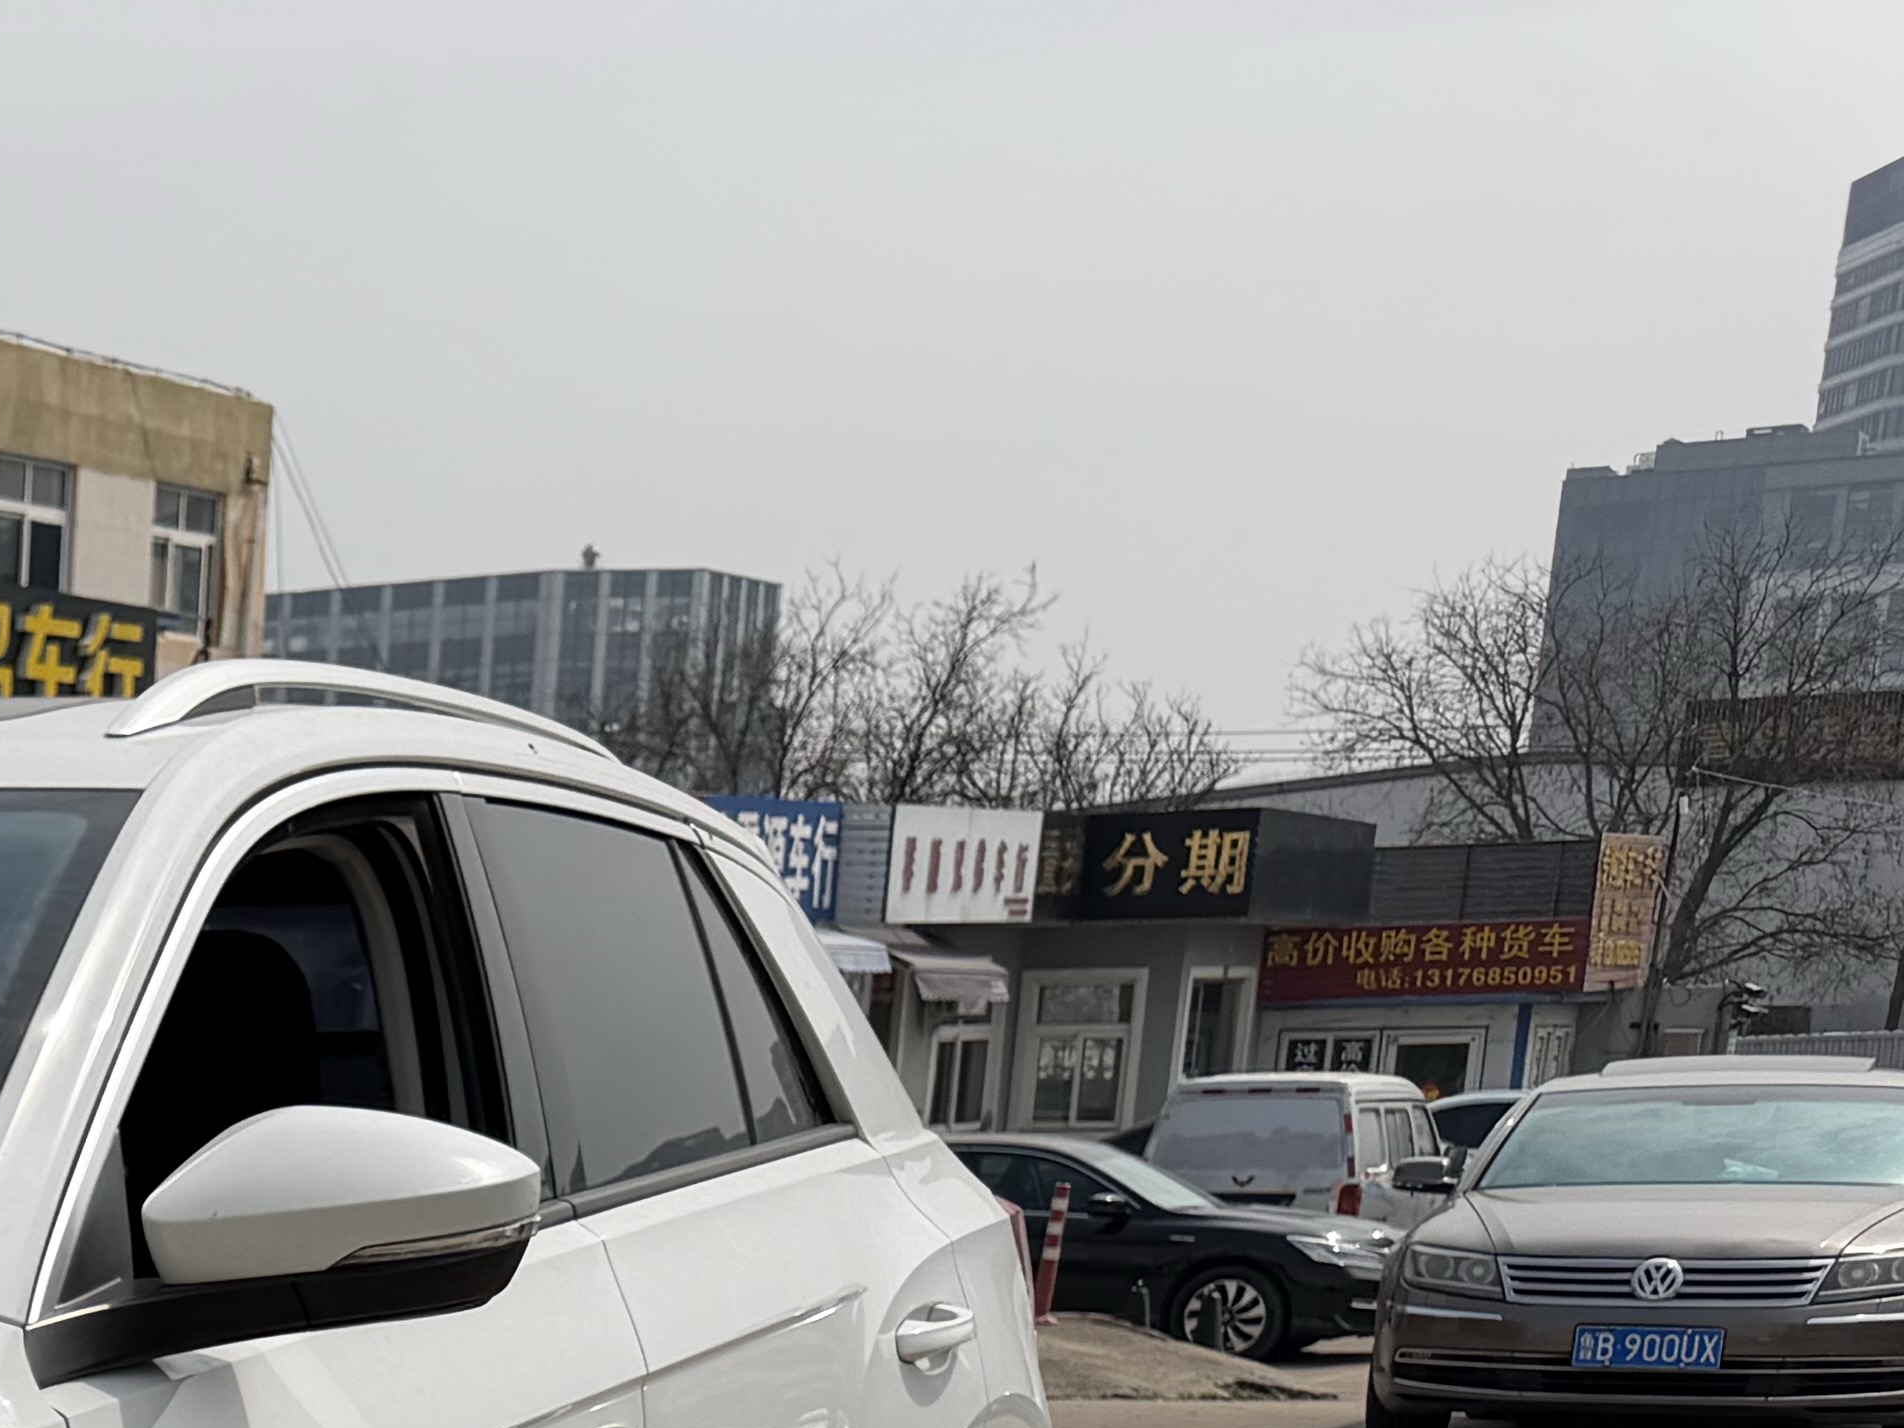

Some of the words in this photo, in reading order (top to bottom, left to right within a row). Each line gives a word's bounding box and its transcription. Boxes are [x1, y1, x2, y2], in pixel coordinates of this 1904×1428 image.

[1266, 922, 1576, 968] 高价收购各种货车
